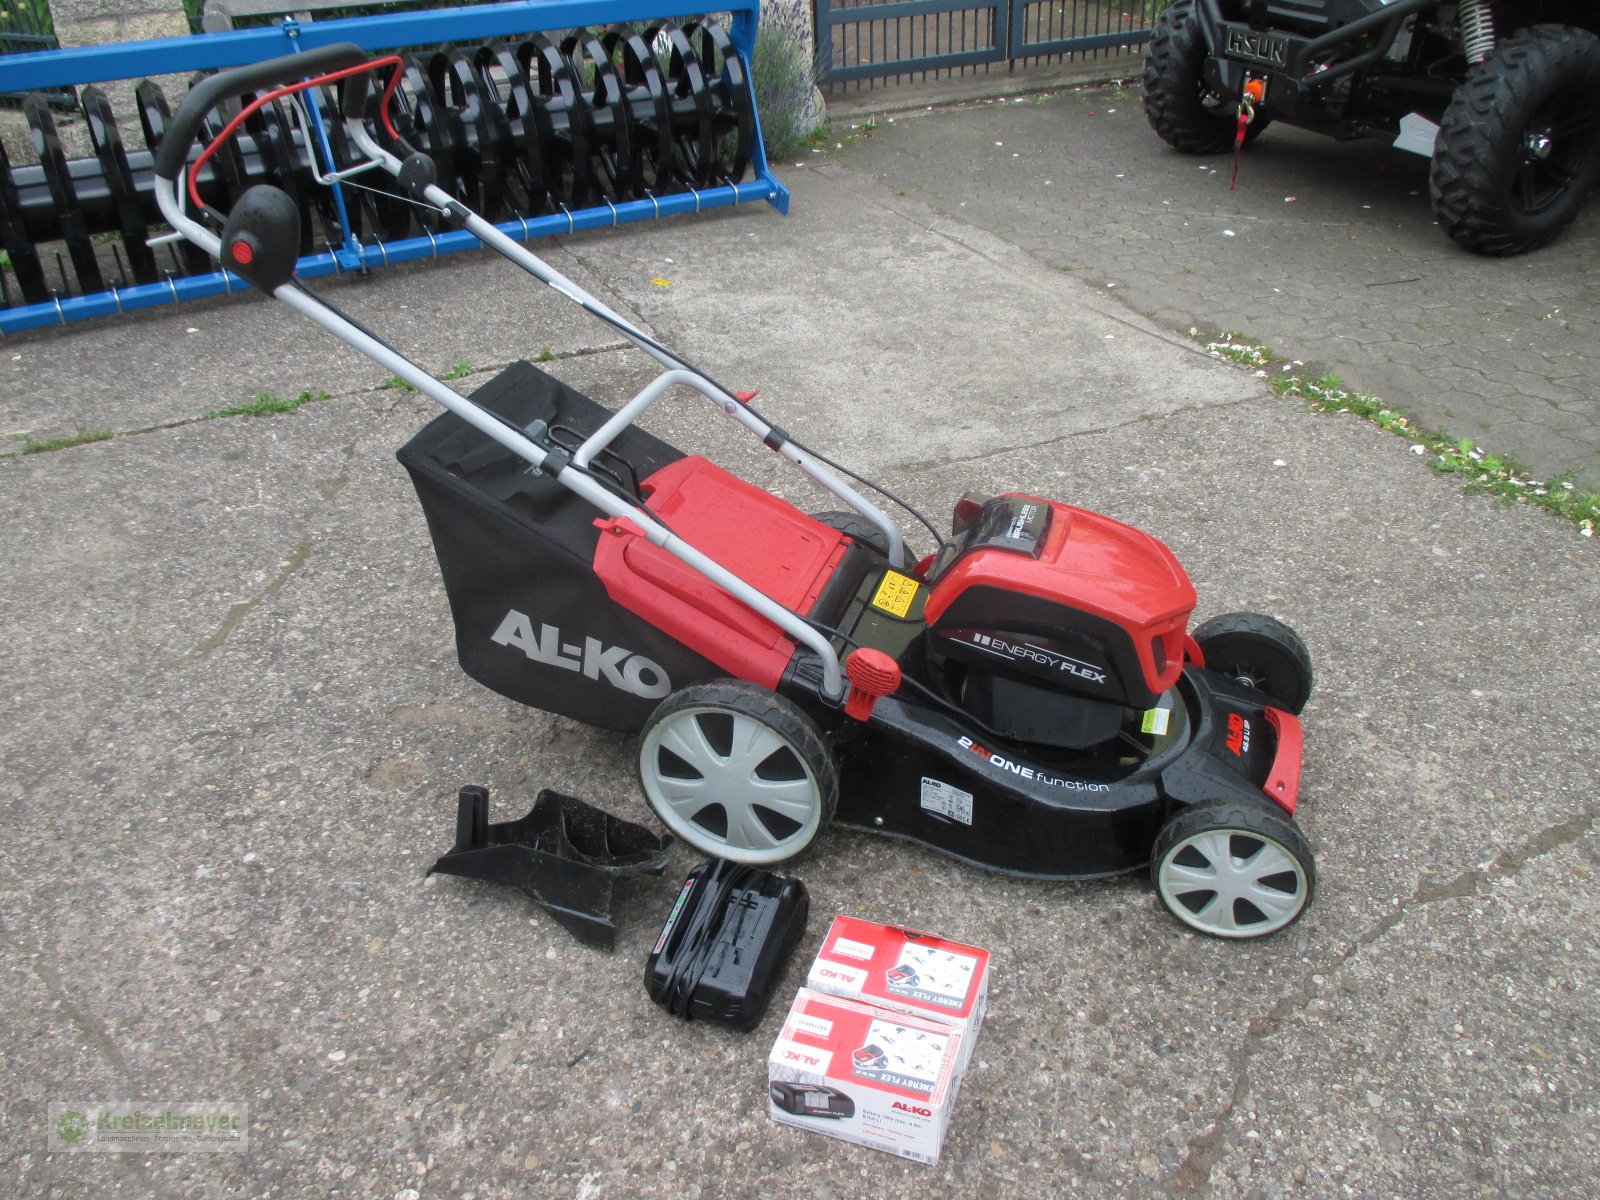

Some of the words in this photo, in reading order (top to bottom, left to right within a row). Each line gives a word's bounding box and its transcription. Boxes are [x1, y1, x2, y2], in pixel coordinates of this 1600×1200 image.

[1012, 504, 1030, 539] BRUSHLESS
[490, 608, 671, 699] AL-KO
[991, 638, 1060, 667] ENERGY
[1060, 661, 1107, 684] FLEX
[1225, 712, 1244, 758] AL-KO
[1036, 772, 1110, 792] function
[819, 968, 856, 983] AL-KO
[912, 988, 933, 1001] FLEX
[932, 995, 963, 1009] ENERGY
[879, 1073, 900, 1085] FLEX
[901, 1078, 935, 1093] ENERGY
[891, 1101, 932, 1117] AL-KO
